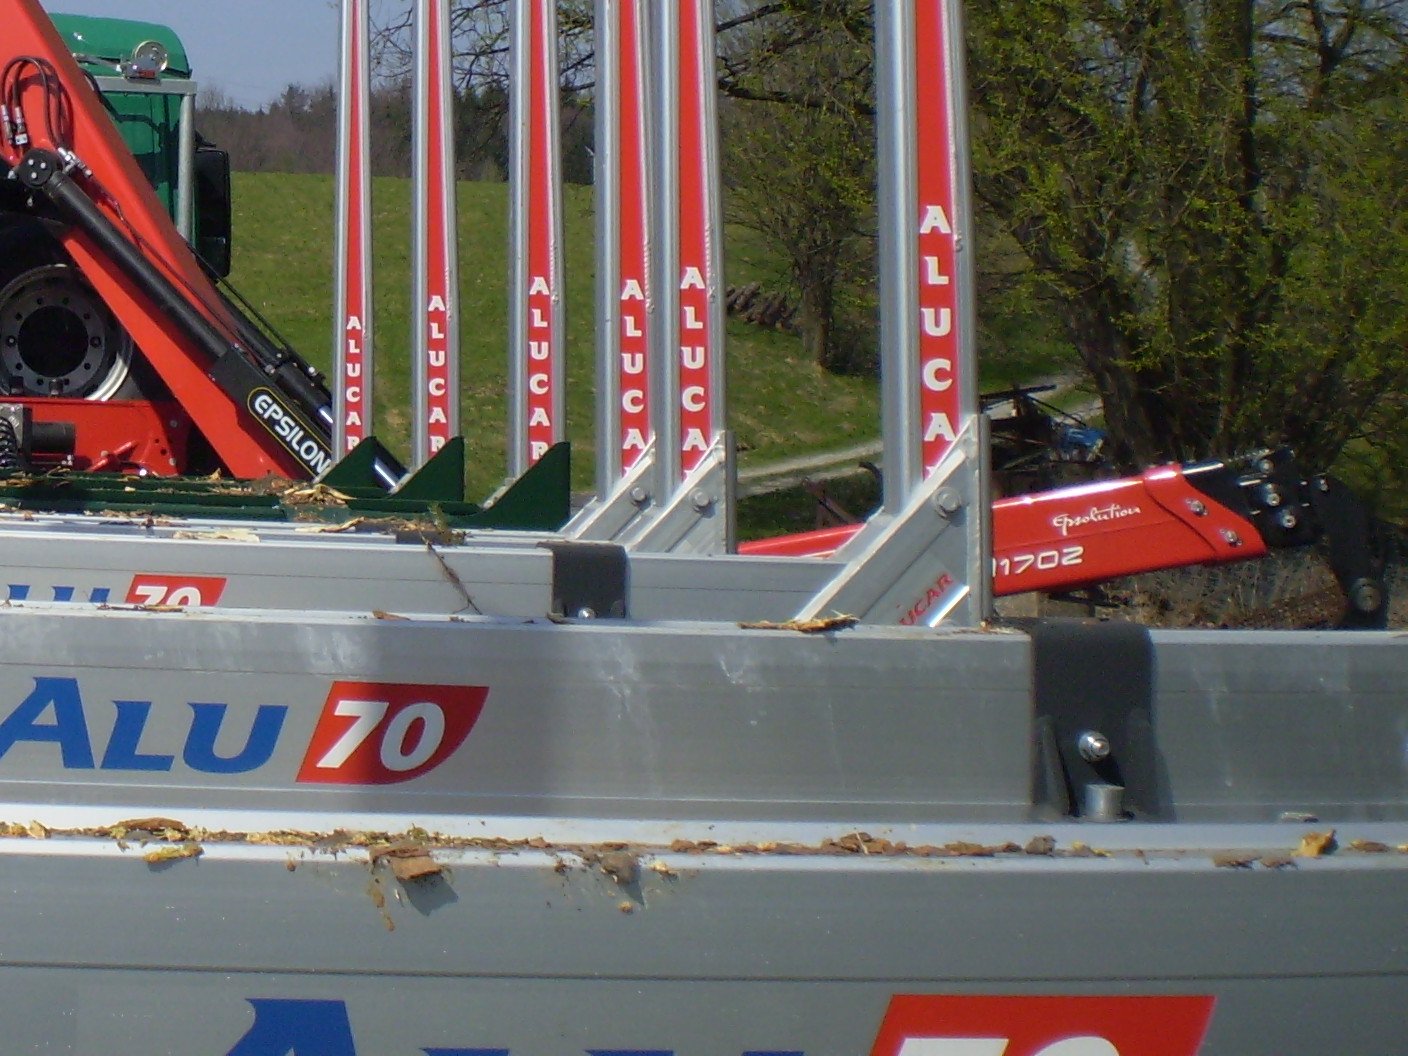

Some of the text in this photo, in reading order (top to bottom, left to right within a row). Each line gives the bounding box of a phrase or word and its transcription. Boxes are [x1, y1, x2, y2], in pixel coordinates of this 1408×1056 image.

[679, 266, 708, 452] ALUCA
[920, 205, 957, 442] ALUCA
[621, 279, 645, 450] ALUCA
[254, 394, 332, 474] EPSILON
[1052, 503, 1142, 537] Epsolution
[899, 573, 954, 626] UCAR
[316, 700, 446, 773] 70
